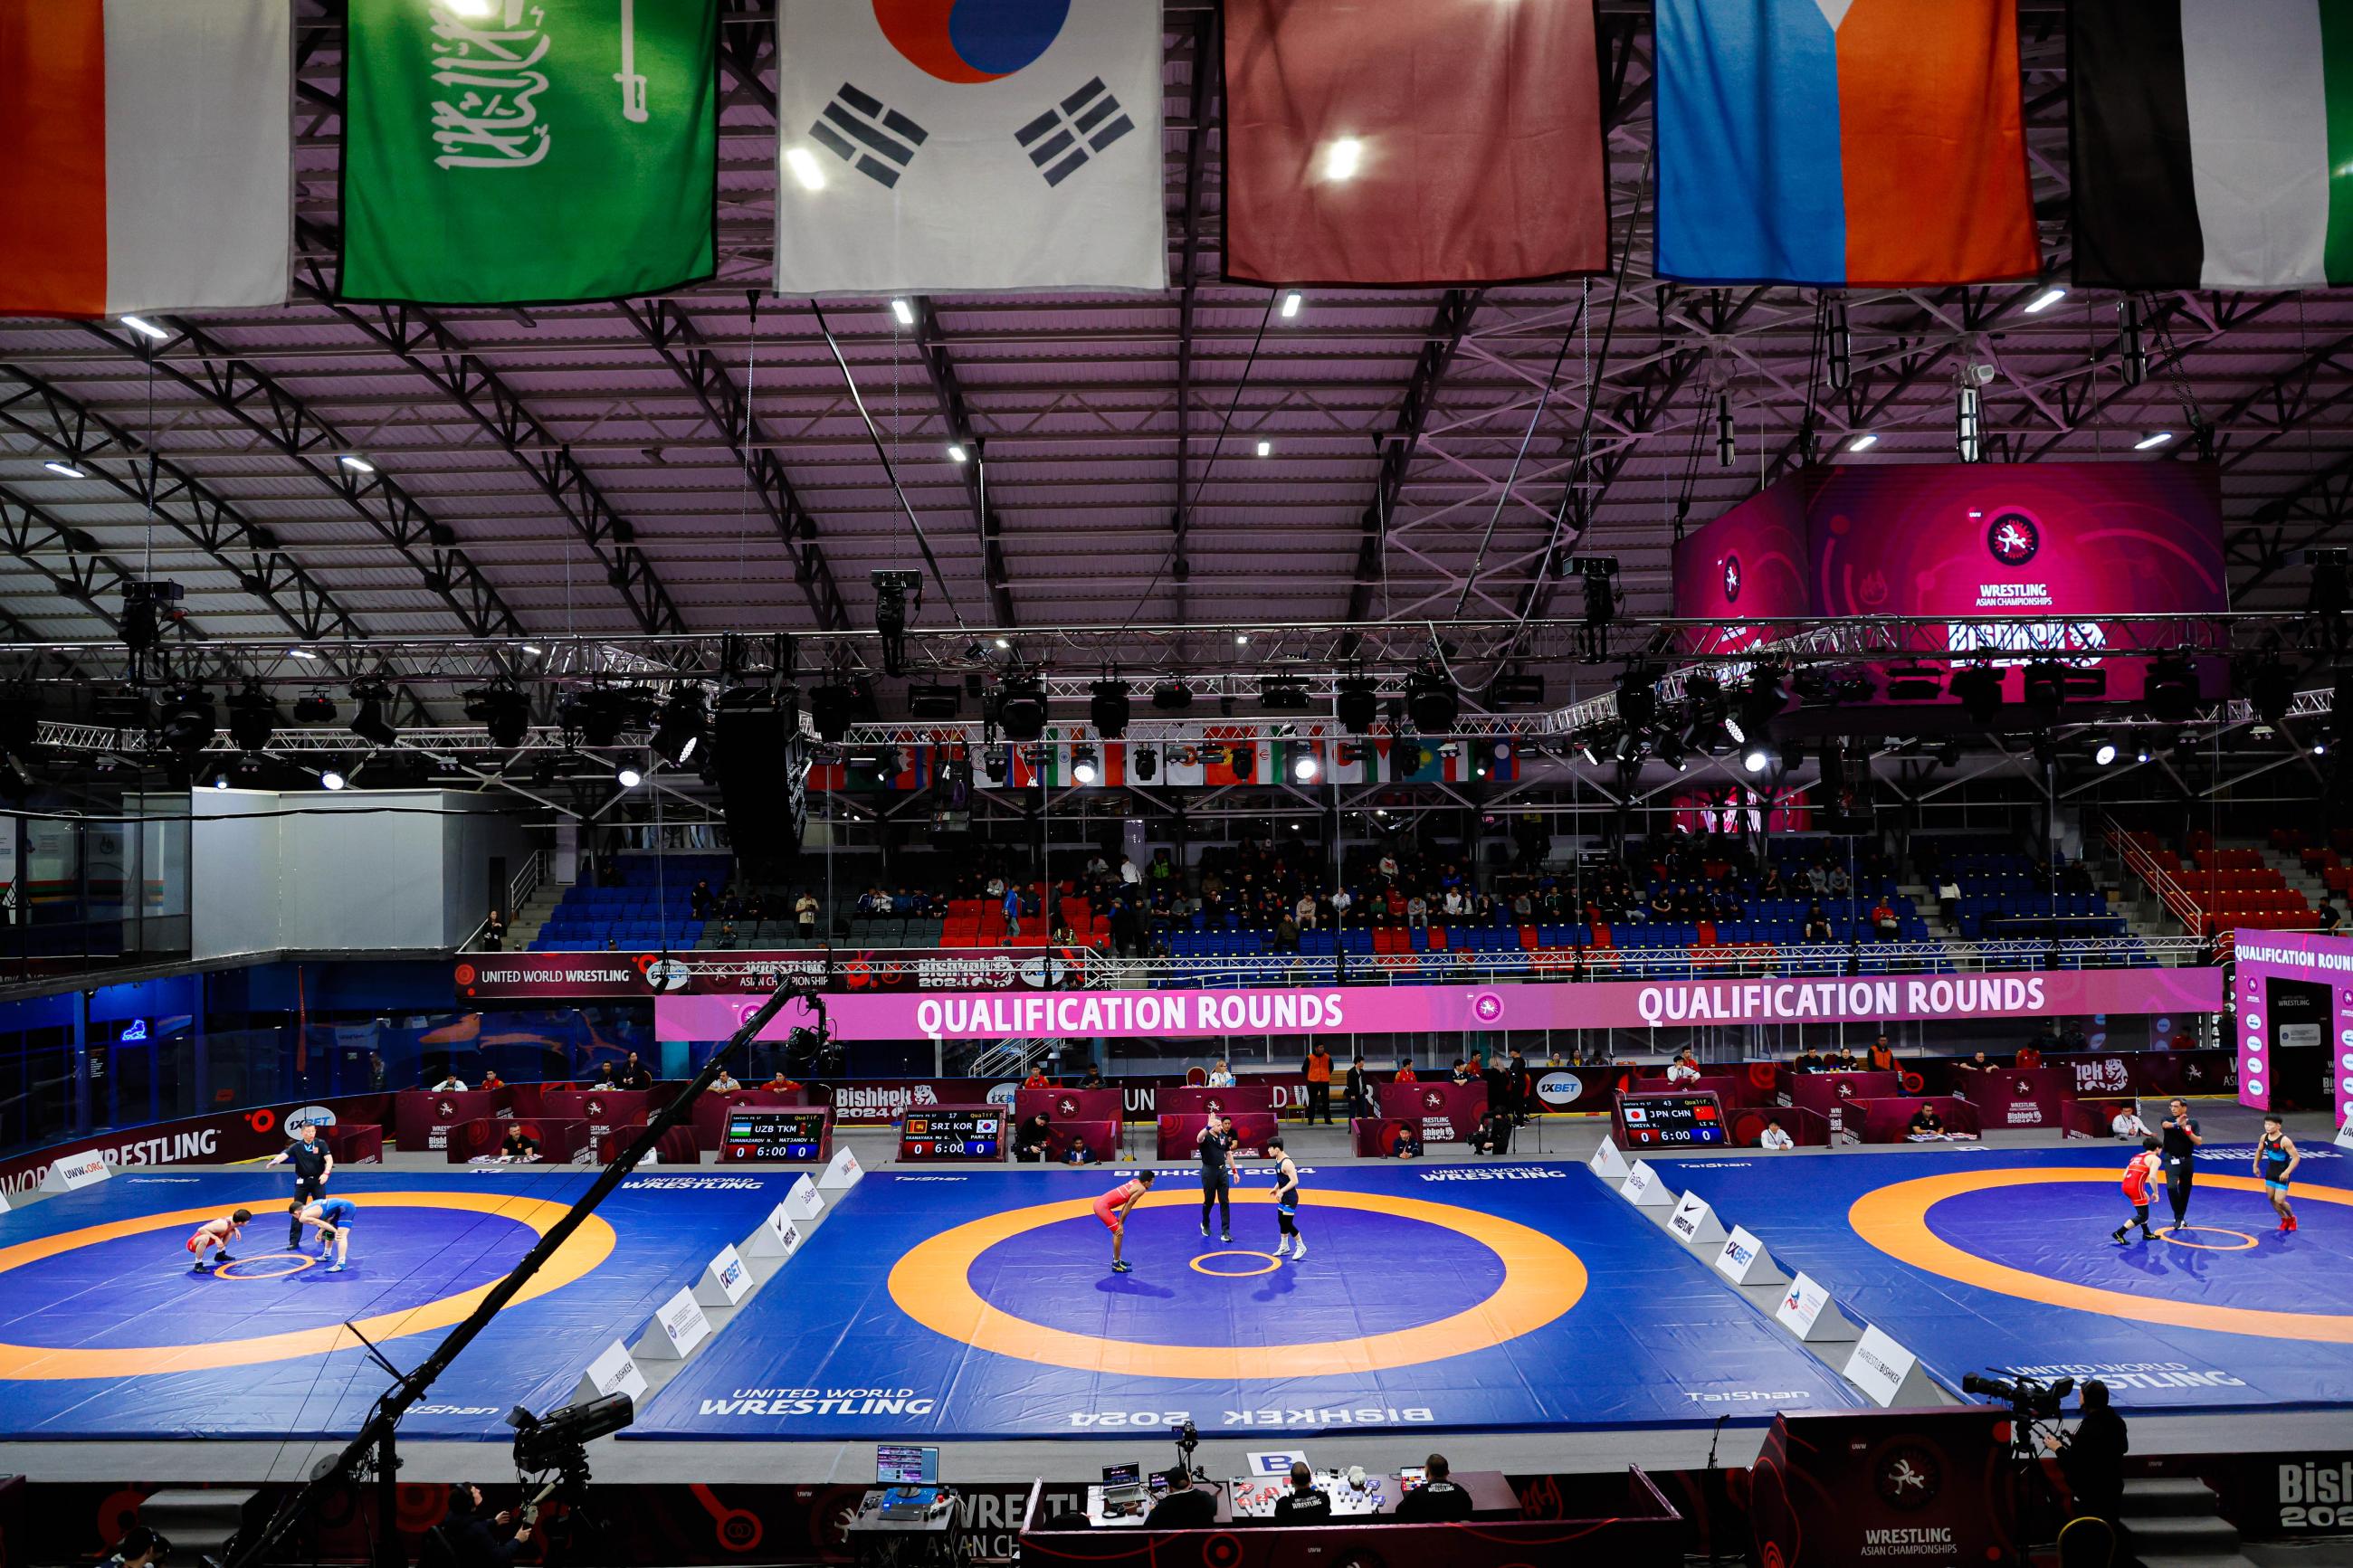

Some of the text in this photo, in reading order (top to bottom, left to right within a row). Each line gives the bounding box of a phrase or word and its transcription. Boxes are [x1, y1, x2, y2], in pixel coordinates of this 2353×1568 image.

[1979, 584, 2047, 597] WRESTLING
[1976, 596, 2053, 607] ASIAN CHAMPIONSHIPS
[2234, 944, 2316, 967] QUALIFICATION
[481, 969, 630, 983] UNITED WORLD WRESTLING
[739, 976, 766, 986] ASIN
[919, 977, 970, 987] 2024
[1637, 976, 2045, 1028] QUALIFICATION ROUNDS
[917, 993, 1344, 1040] QUALIFICATION ROUNDS
[1540, 1082, 1578, 1093] 1XBET
[836, 1088, 913, 1107] Bishkek
[836, 1107, 891, 1118] 2024
[948, 1112, 958, 1120] 17
[1649, 1109, 1691, 1118] JPN CHN
[754, 1125, 797, 1133] UZB TKM
[930, 1122, 974, 1130] SRI KOR
[1641, 1130, 1710, 1143] 0 6:00 0
[737, 1146, 806, 1158] 0 6:00 0
[914, 1143, 985, 1155] 0 6:00 0
[63, 1160, 104, 1180] UWW.ORG
[1419, 1171, 1567, 1182] WRESTLING
[621, 1182, 765, 1190] WRESTLING
[1725, 1240, 1753, 1268] 1XBET
[719, 1259, 742, 1289] 1XBET
[1857, 1347, 1902, 1386] #WRESTLEBISHKEK
[2005, 1362, 2189, 1376] UNITED WORLD
[732, 1388, 914, 1399] UNITED WORLD
[1683, 1390, 1810, 1402] TaiShan
[698, 1398, 936, 1416] WRESTLING
[1224, 1408, 1435, 1426] BISHKEK
[1260, 1455, 1294, 1472] B
[1291, 1498, 1322, 1510] WRESTLING
[1865, 1527, 1951, 1545] WRESTLING
[1861, 1544, 1958, 1556] ASIAN CHAMPIONSHIPS
